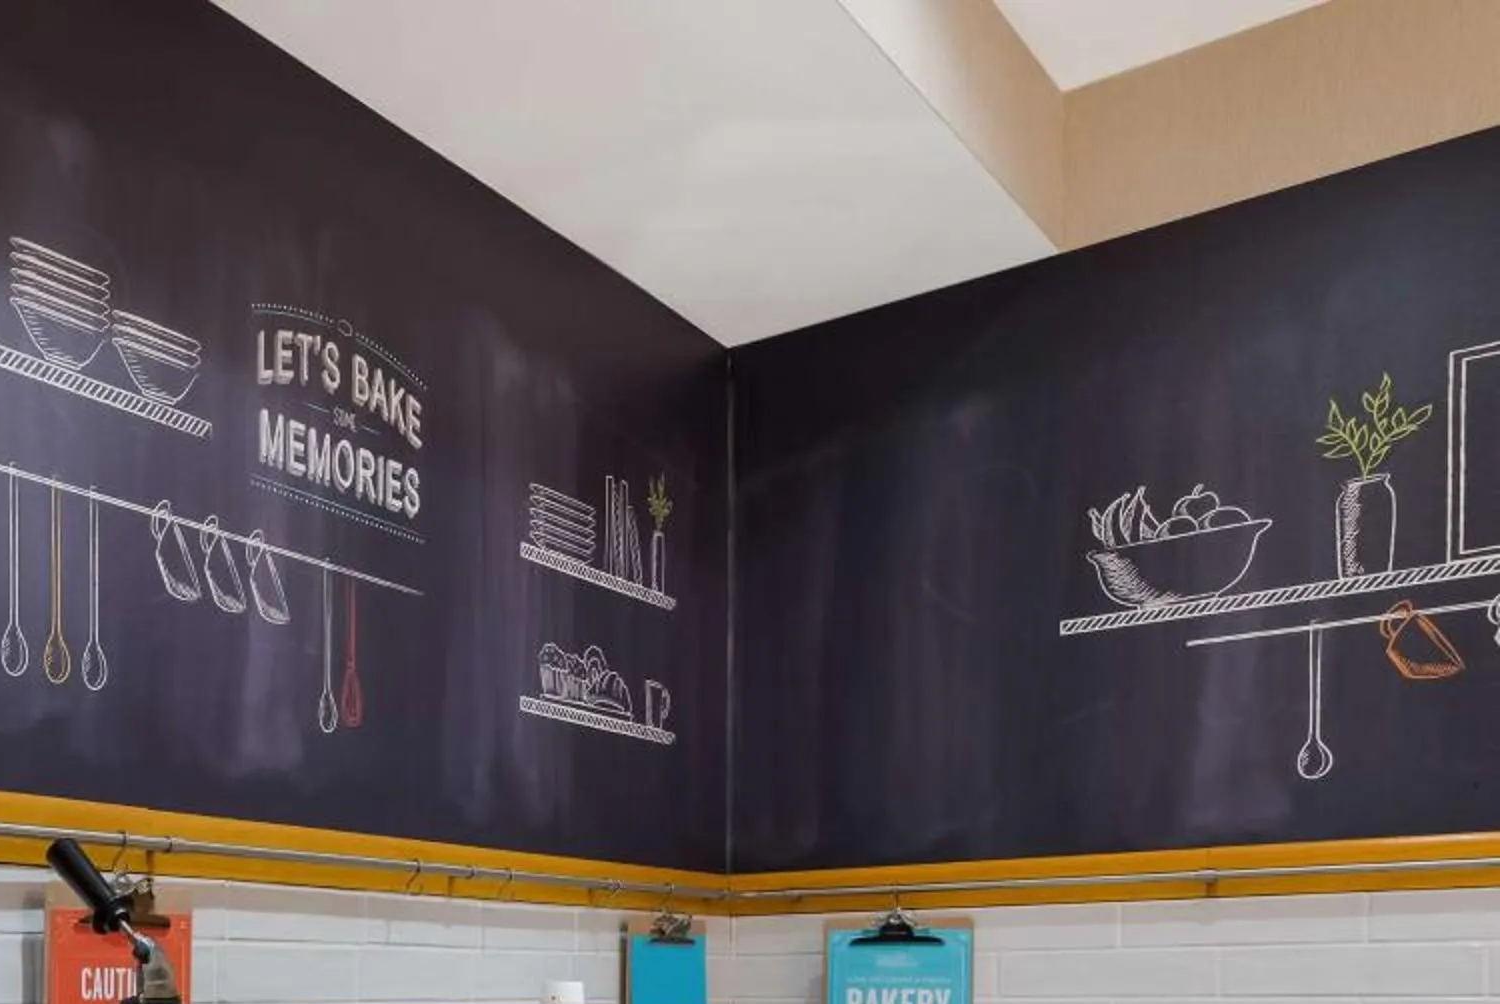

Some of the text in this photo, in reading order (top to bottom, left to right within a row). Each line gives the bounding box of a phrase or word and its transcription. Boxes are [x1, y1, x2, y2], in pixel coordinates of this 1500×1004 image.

[257, 330, 424, 449] LET'S BAKE
[258, 408, 421, 519] MEMORIES
[80, 966, 137, 1001] CAUTI
